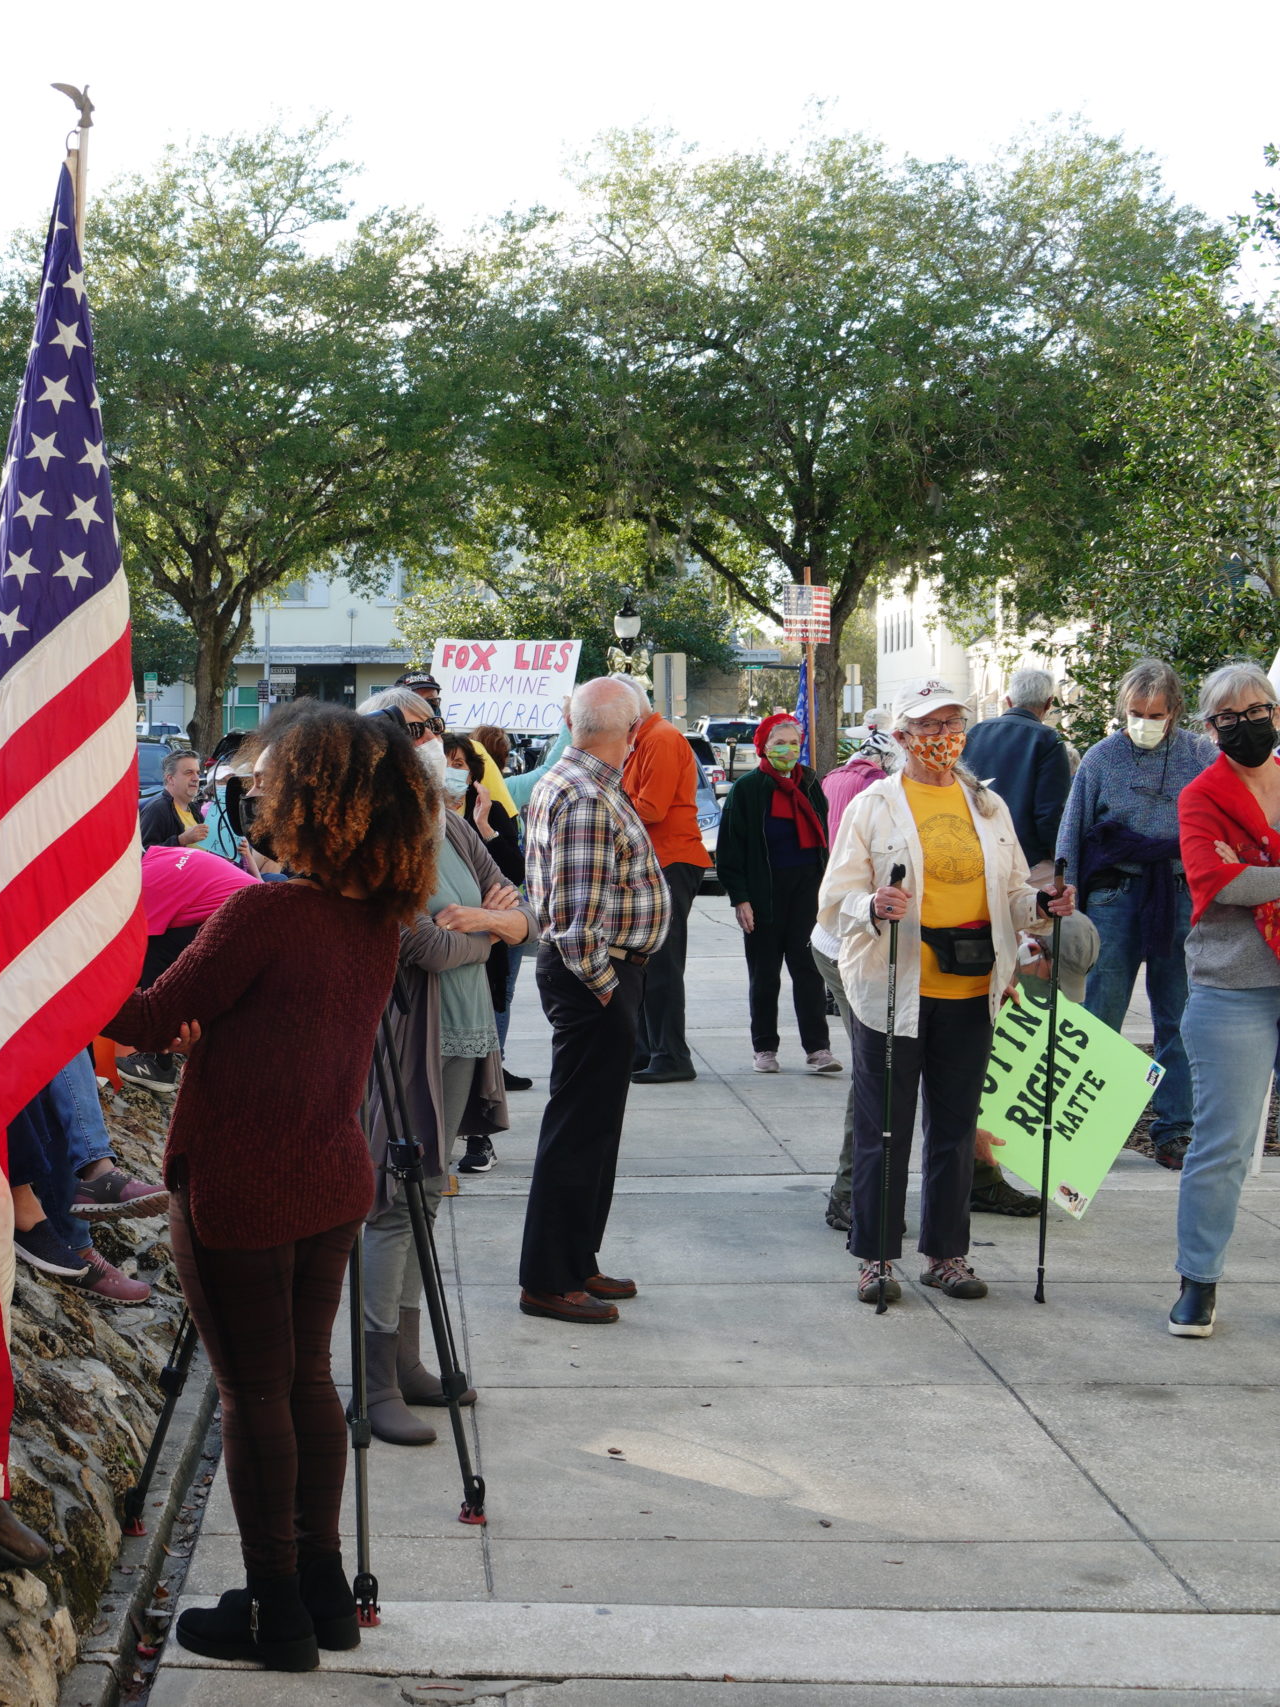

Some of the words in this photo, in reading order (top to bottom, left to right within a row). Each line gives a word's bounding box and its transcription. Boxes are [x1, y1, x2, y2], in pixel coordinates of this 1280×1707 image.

[441, 643, 497, 672] FOX
[514, 642, 574, 673] LIES
[452, 674, 550, 697] UNDERMINE
[444, 700, 567, 729] EMOCRACY
[1005, 1018, 1090, 1137] RIGHTS
[1052, 1069, 1107, 1142] MATTE
